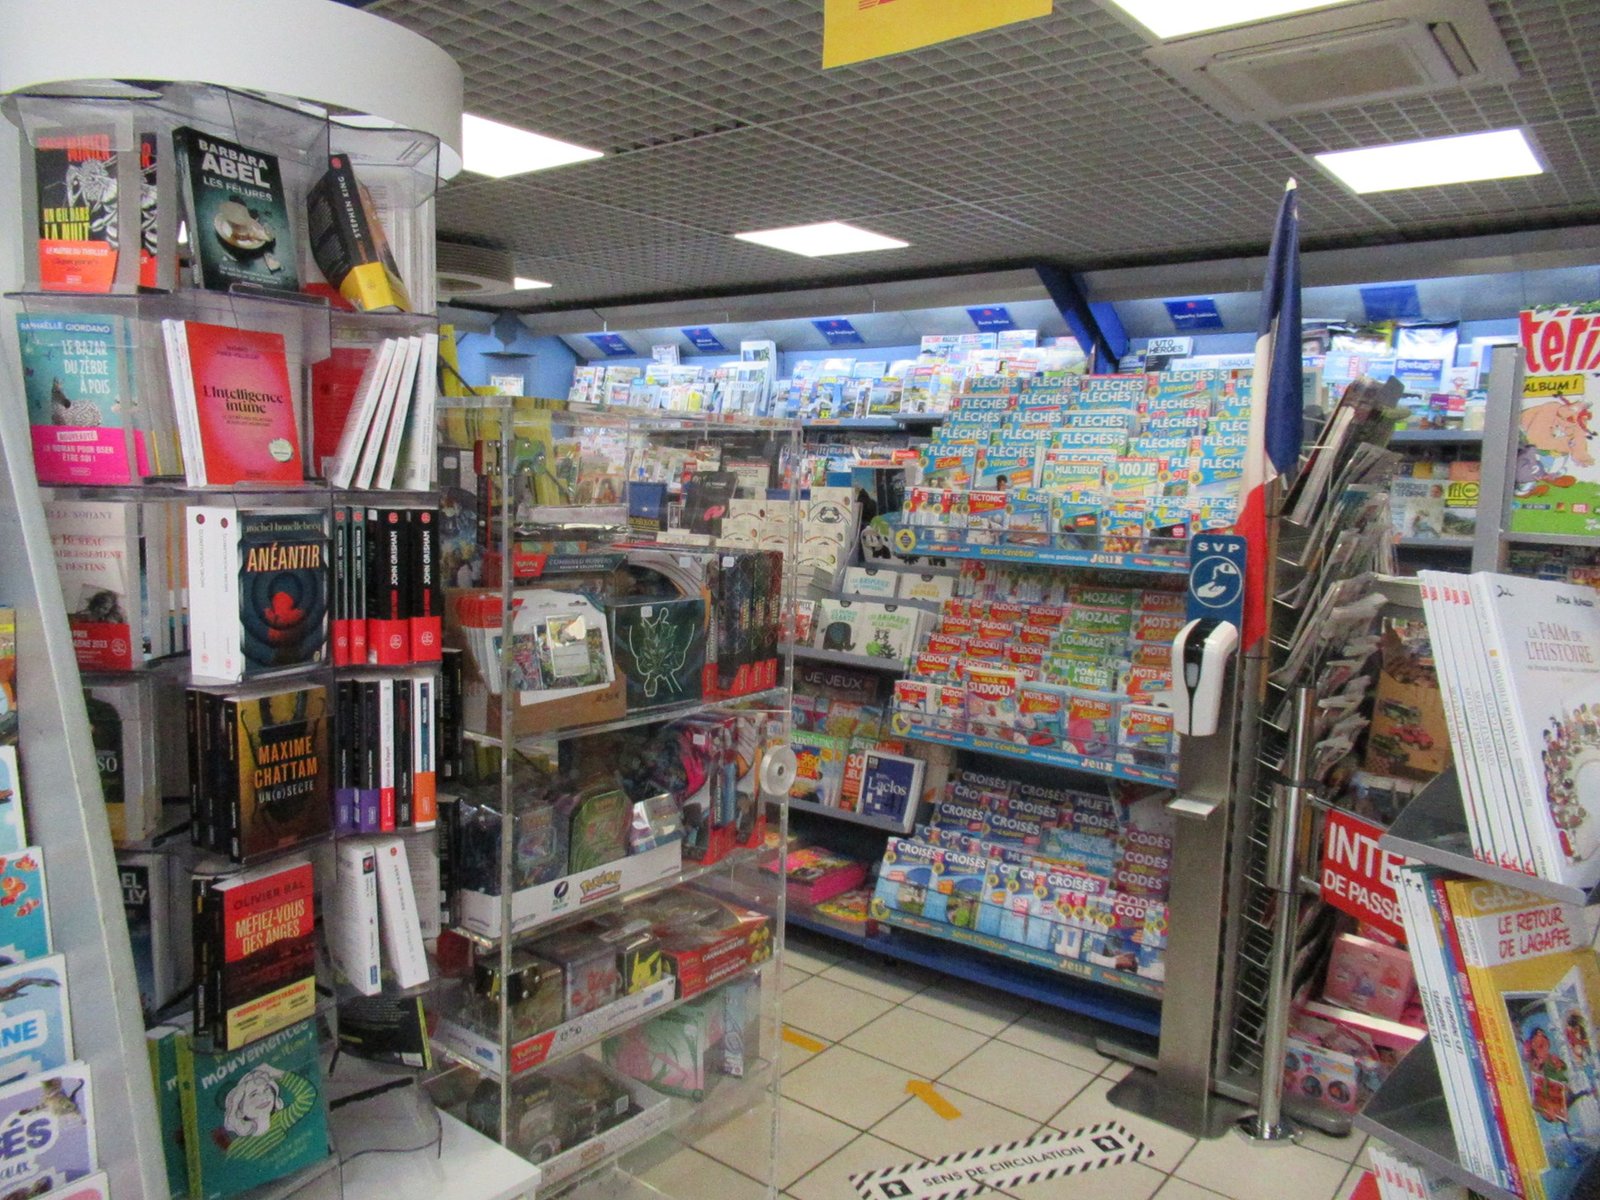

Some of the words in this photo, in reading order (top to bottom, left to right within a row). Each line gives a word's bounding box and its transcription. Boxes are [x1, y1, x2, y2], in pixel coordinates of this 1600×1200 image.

[198, 139, 268, 170] BARBARA
[202, 153, 271, 188] ABEL
[203, 177, 223, 189] LES
[338, 176, 350, 198] KING
[344, 200, 361, 238] STEPHEN
[65, 324, 110, 333] GIORDANO
[63, 340, 72, 355] LE
[64, 360, 78, 374] DU
[1397, 360, 1442, 370] Bretagne
[90, 379, 110, 394] POIS
[1523, 381, 1569, 394] ALBUM
[225, 400, 267, 414] intime
[1118, 463, 1140, 476] 100
[247, 541, 320, 572] ANÉANTIR
[423, 530, 431, 564] GRISHAM
[1197, 542, 1240, 553] SVP
[1537, 621, 1570, 642] FAIM
[1571, 631, 1583, 642] DE
[1525, 640, 1594, 664] L'HISTOIRE
[968, 682, 1010, 696] SUDOKU
[258, 735, 313, 765] MAXIME
[254, 757, 318, 788] CHATTAM
[868, 776, 907, 796] Laclos
[991, 815, 1040, 835] CROISÉS
[1323, 870, 1346, 896] DE
[233, 889, 280, 910] OLIVIER
[235, 899, 305, 939] MÉFIEZ-VOUS
[1498, 916, 1512, 935] LE
[1517, 907, 1564, 932] RETOUR
[242, 933, 264, 956] DES
[266, 922, 300, 943] ANGES
[1499, 939, 1515, 958] DE
[1520, 928, 1571, 955] LAGAFFE
[922, 1170, 963, 1188] SENS
[966, 1166, 987, 1179] DE
[989, 1145, 1085, 1173] CIRCULATION
